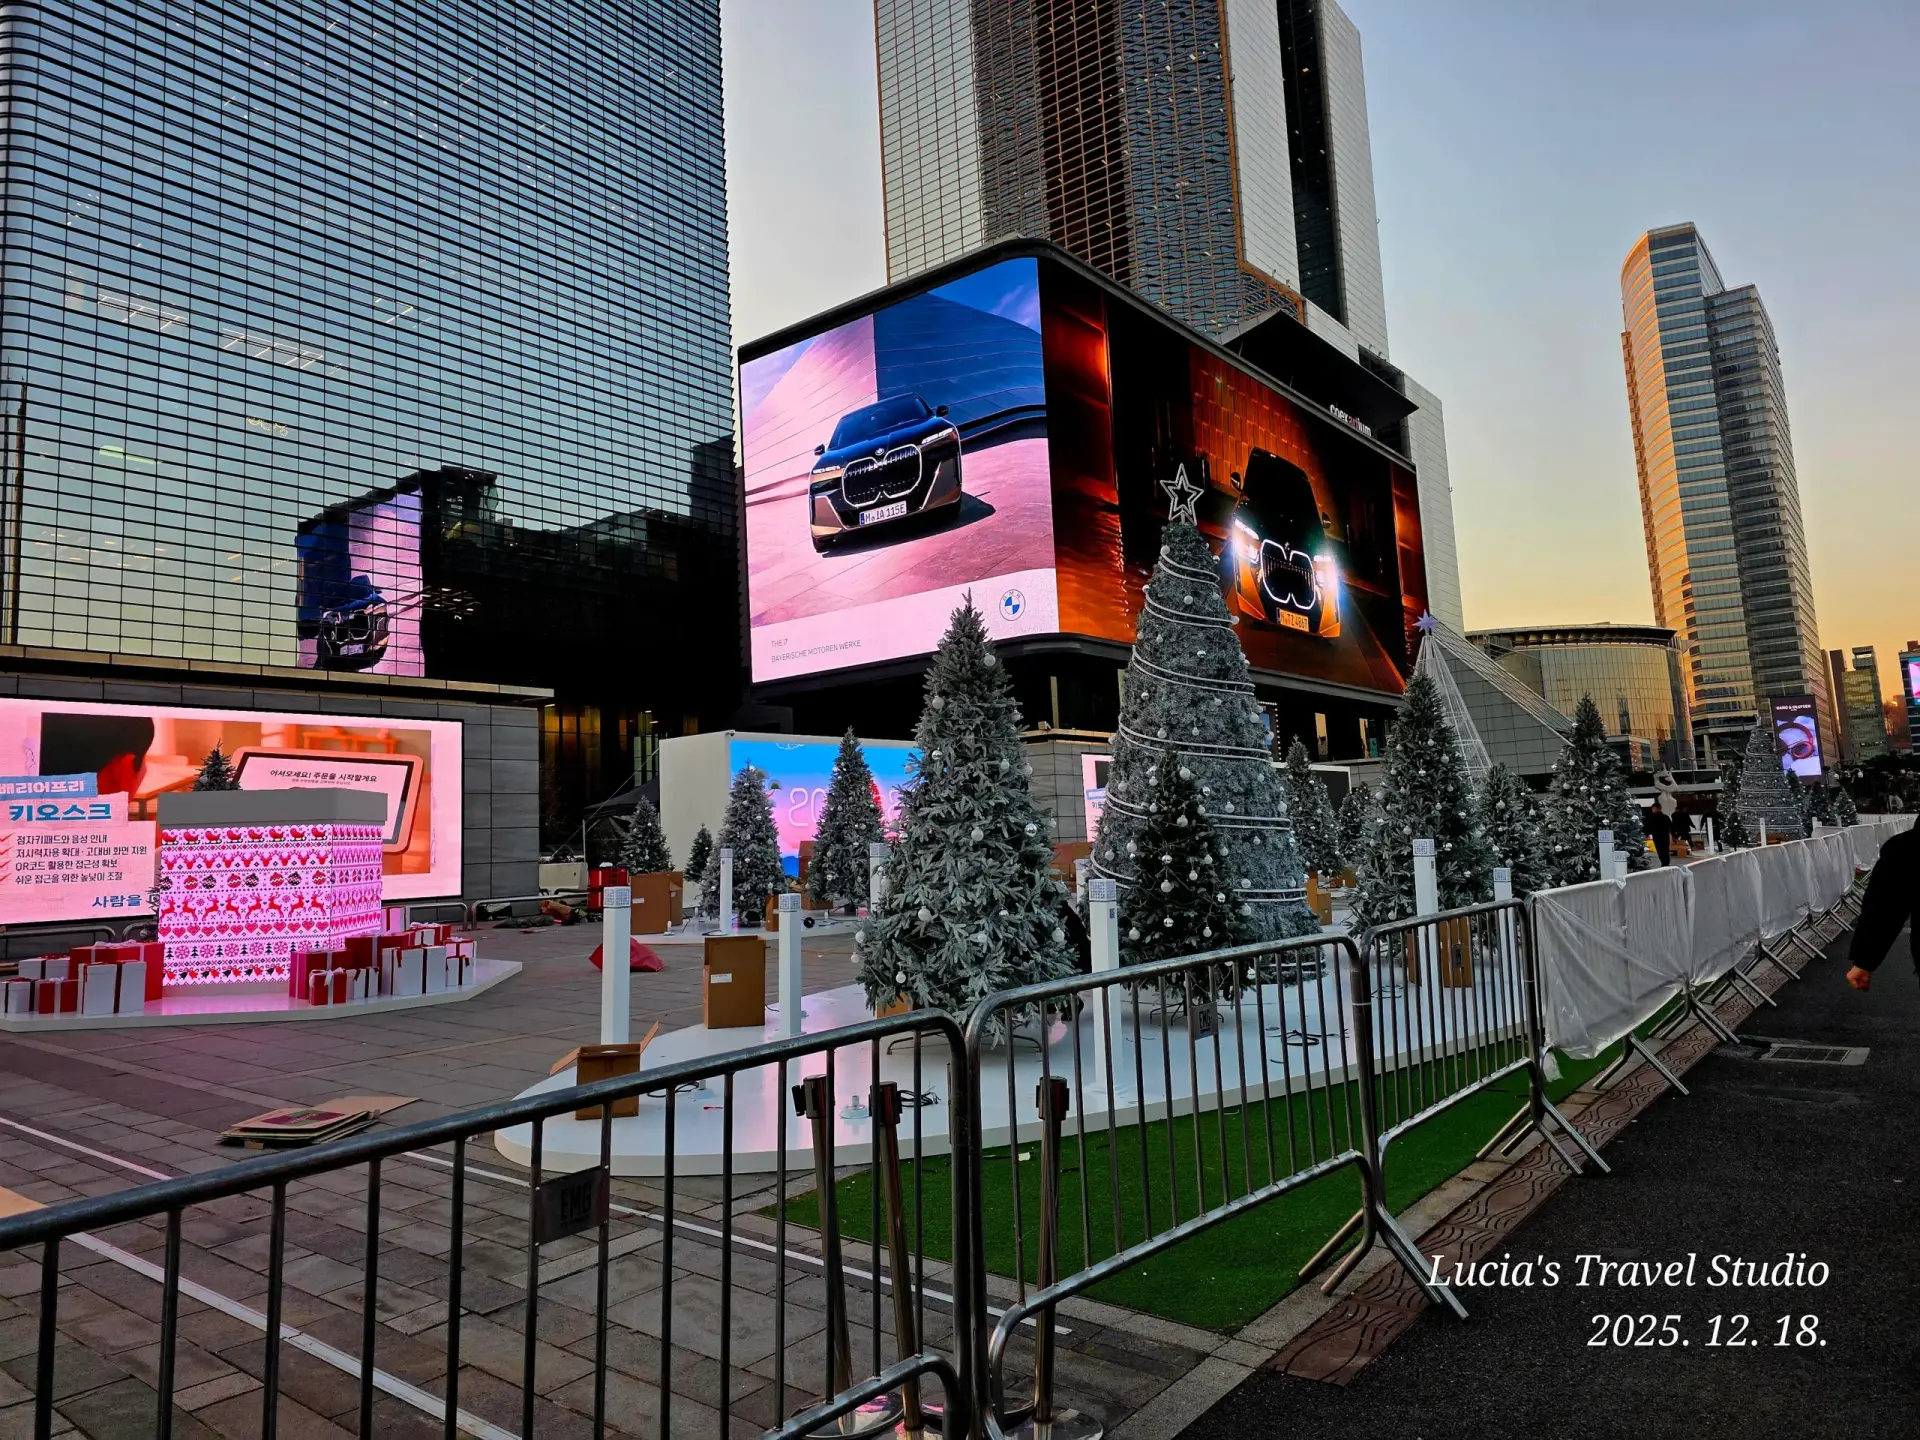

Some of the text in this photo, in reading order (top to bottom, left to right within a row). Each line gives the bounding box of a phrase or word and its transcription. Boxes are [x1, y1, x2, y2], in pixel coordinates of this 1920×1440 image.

[770, 640, 782, 648] THE
[771, 639, 861, 663] BAYERISCHE MOTOREN WERKE
[270, 769, 312, 779] 어서오세요!
[313, 771, 337, 781] 주문을
[338, 773, 378, 783] 시작할게요
[0, 780, 85, 795] 배리어프리
[9, 803, 112, 822] 키오스크
[16, 834, 107, 845] 점자키패드와 음성 안내
[16, 847, 60, 859] 저시력자용
[62, 847, 80, 857] 확대
[86, 847, 111, 857] 고대비
[112, 846, 129, 856] 화면
[131, 845, 147, 855] 지원
[15, 858, 118, 871] QR코드 활용한 접근성 확보
[15, 871, 123, 885] 쉬운 접근을 위한 높낮이 조절
[92, 894, 143, 908] 사람을
